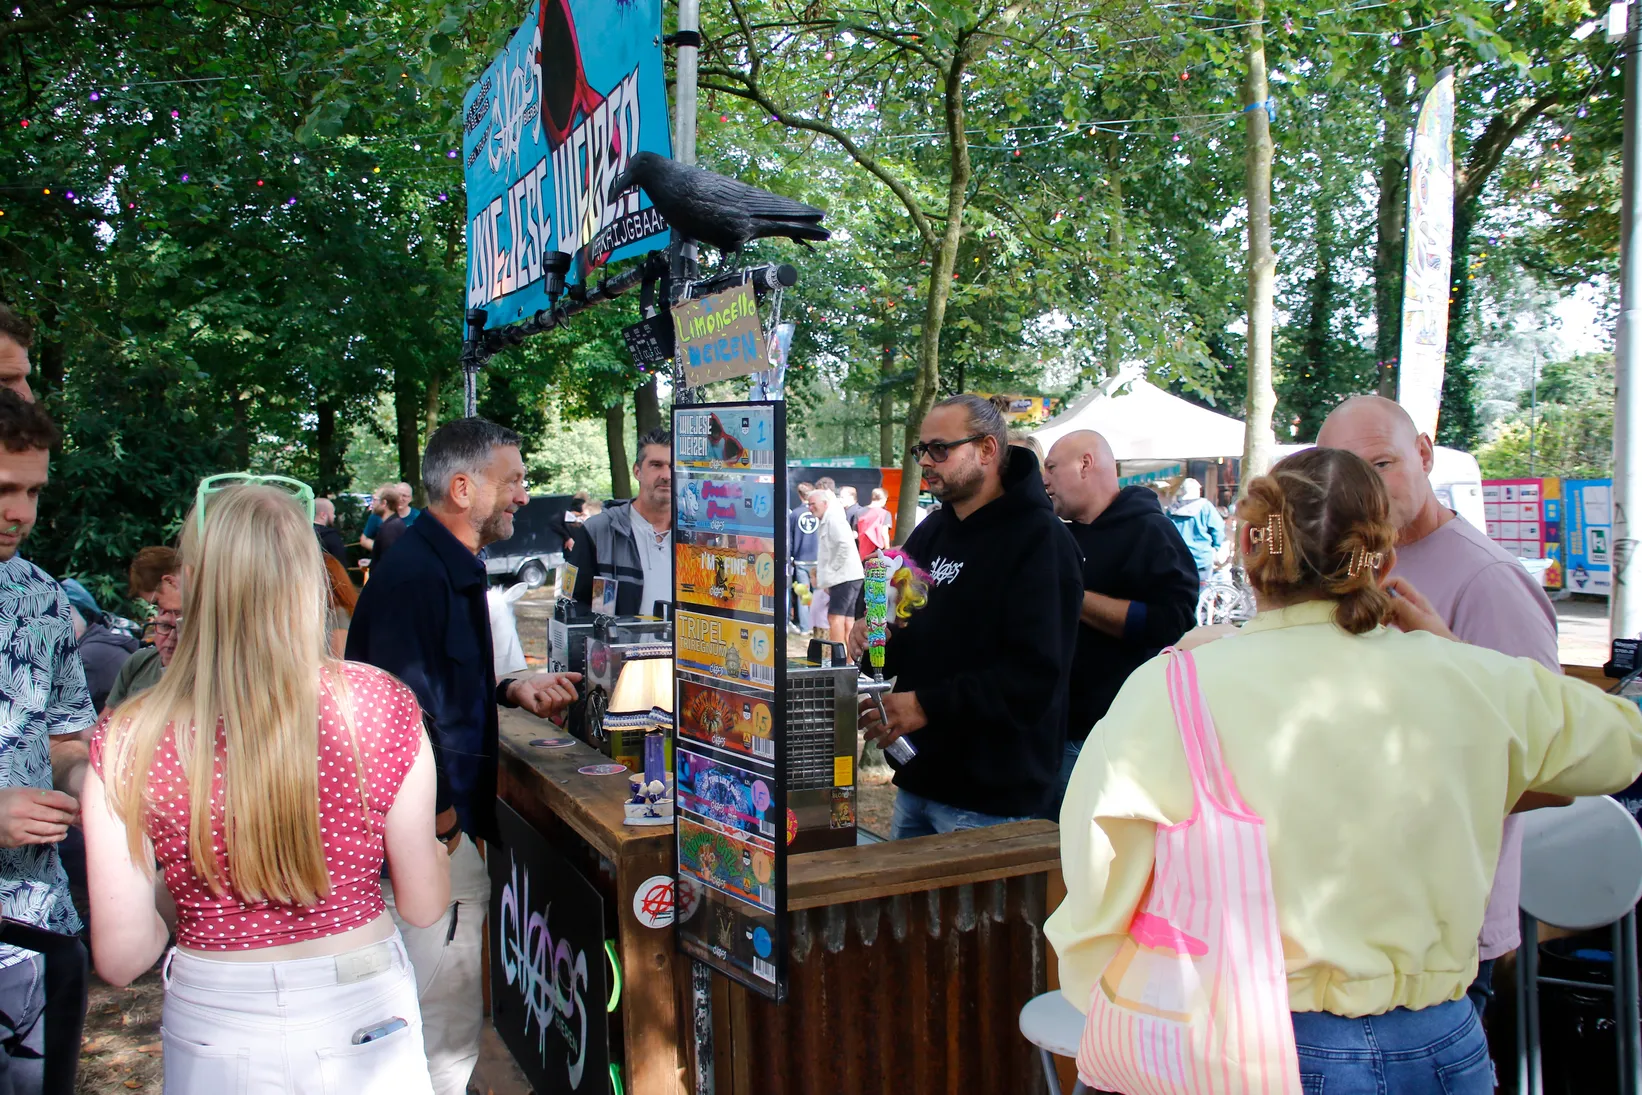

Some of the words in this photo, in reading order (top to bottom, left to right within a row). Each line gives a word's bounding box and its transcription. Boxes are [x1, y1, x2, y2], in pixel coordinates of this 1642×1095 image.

[680, 415, 712, 435] WIEJESE
[680, 436, 708, 456] WEIZEN
[725, 556, 747, 576] FINE
[679, 615, 727, 646] TRIPEL
